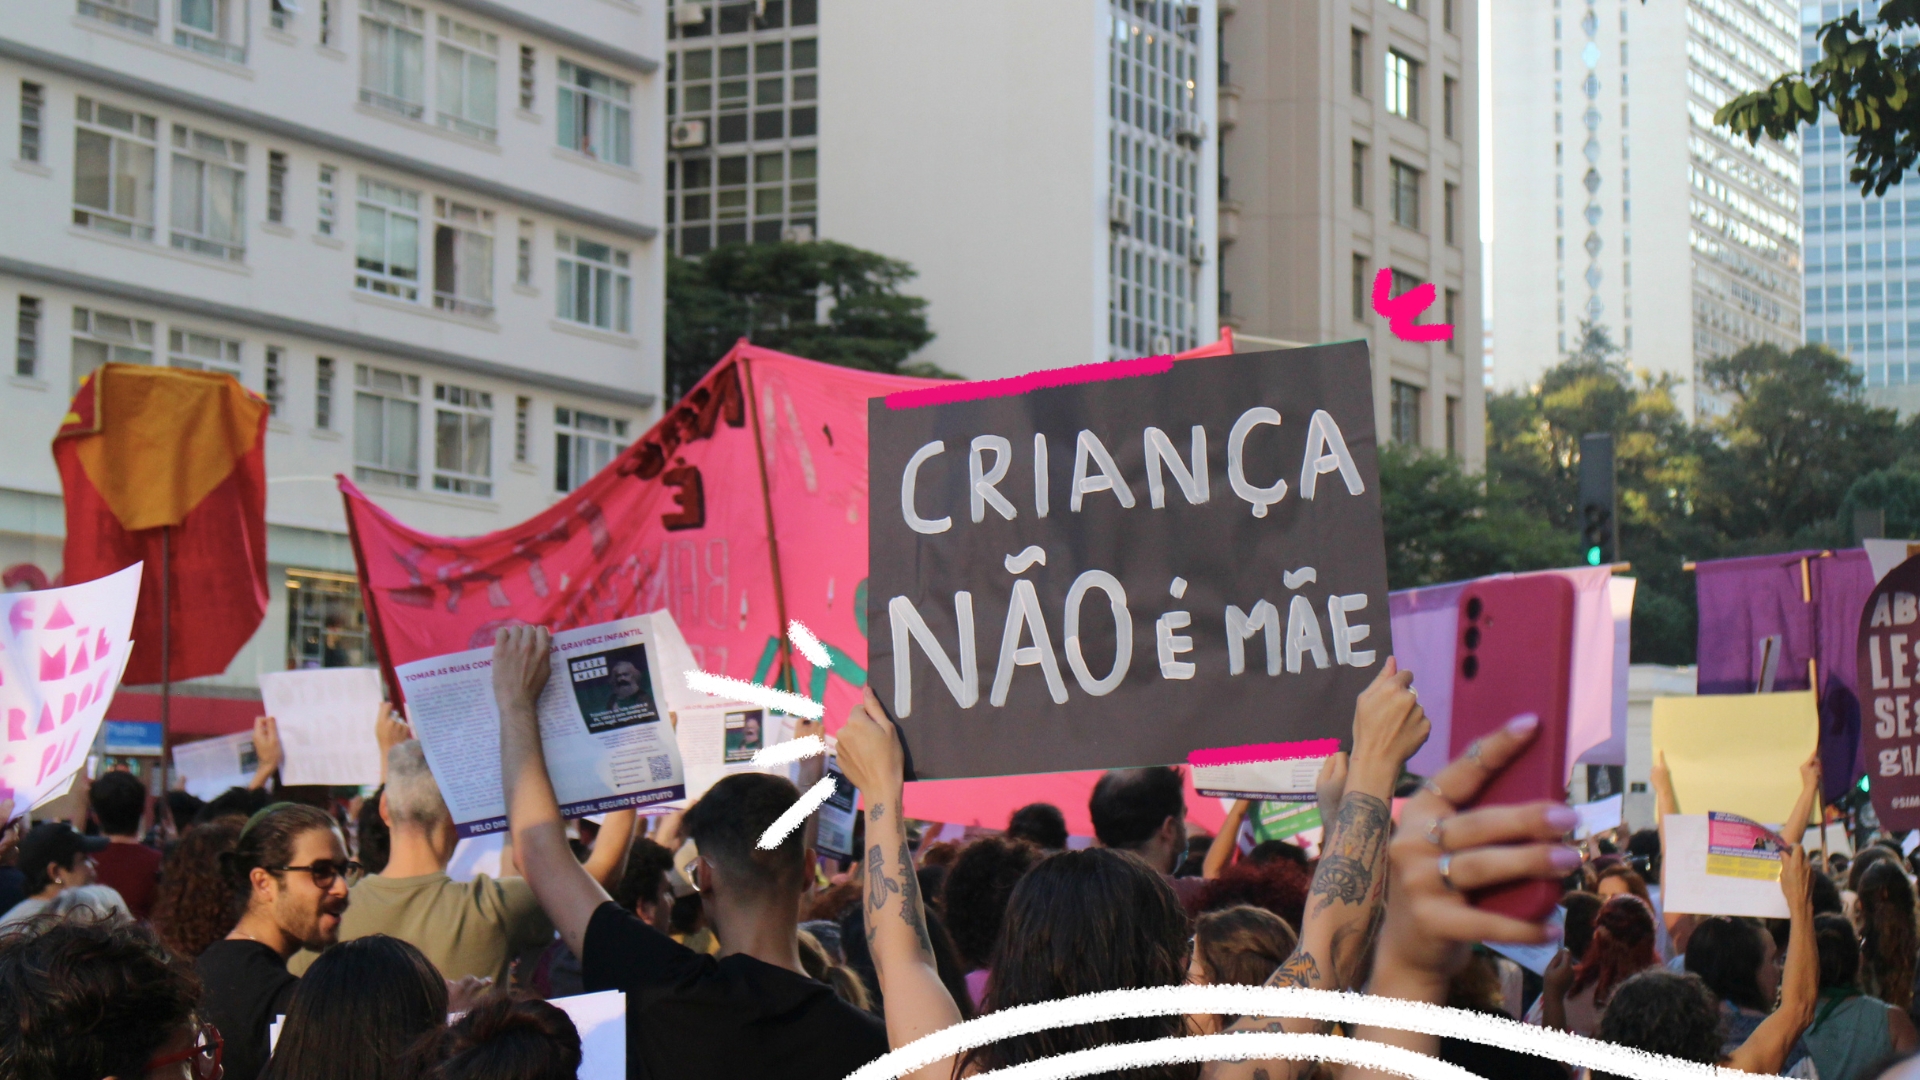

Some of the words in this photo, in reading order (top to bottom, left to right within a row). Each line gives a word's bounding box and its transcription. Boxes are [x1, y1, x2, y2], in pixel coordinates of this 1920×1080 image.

[901, 407, 1365, 535] CRIANÇA
[404, 670, 436, 682] TOMAR
[437, 667, 448, 676] AS
[449, 663, 471, 673] RUAS
[560, 636, 603, 651] GRAVIDEZ
[605, 628, 644, 642] INFANTIL
[889, 545, 1134, 719] NÃO
[1155, 576, 1196, 680] É
[1224, 566, 1376, 677] MÃE
[576, 659, 602, 669] CASA
[578, 669, 604, 679] MARX
[470, 822, 492, 834] PELO
[571, 804, 598, 816] LEGAL,
[598, 797, 630, 811] SEGURO
[630, 796, 637, 805] E
[637, 790, 674, 804] GRATUITO
